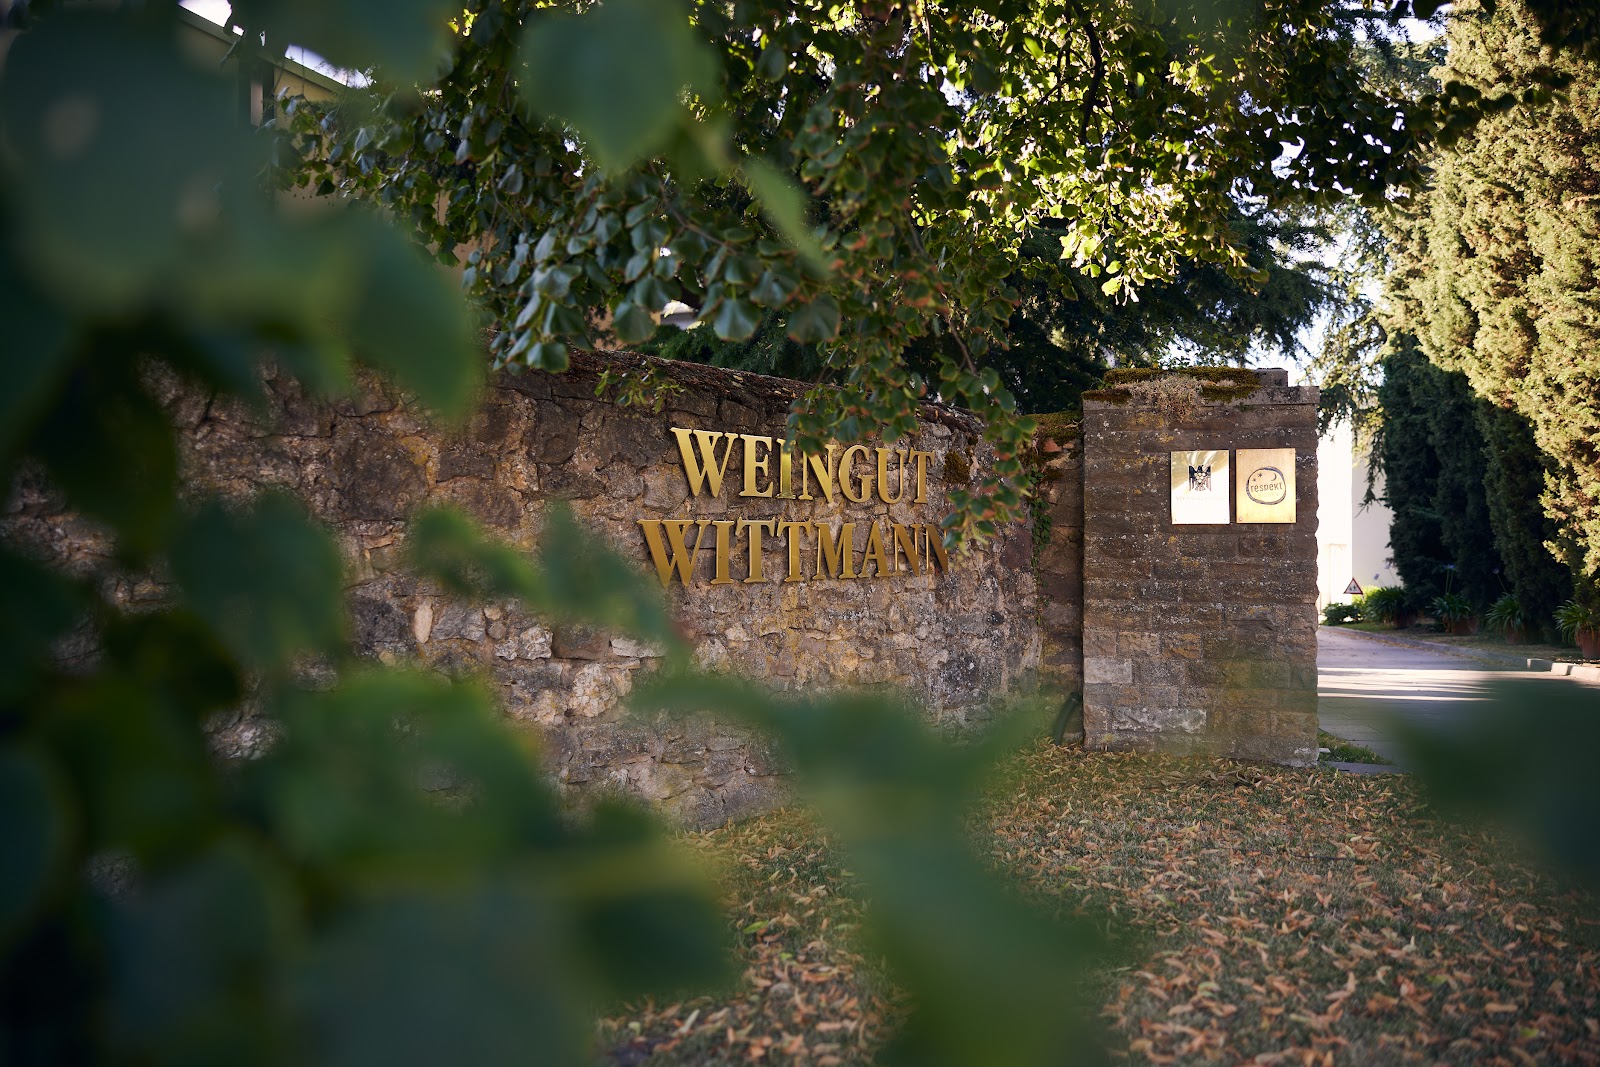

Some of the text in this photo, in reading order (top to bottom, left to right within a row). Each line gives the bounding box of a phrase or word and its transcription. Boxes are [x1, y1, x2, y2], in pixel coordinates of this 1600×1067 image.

[670, 427, 935, 504] WEINGUT
[1250, 482, 1283, 492] respekt
[636, 517, 949, 588] WITTMANN
